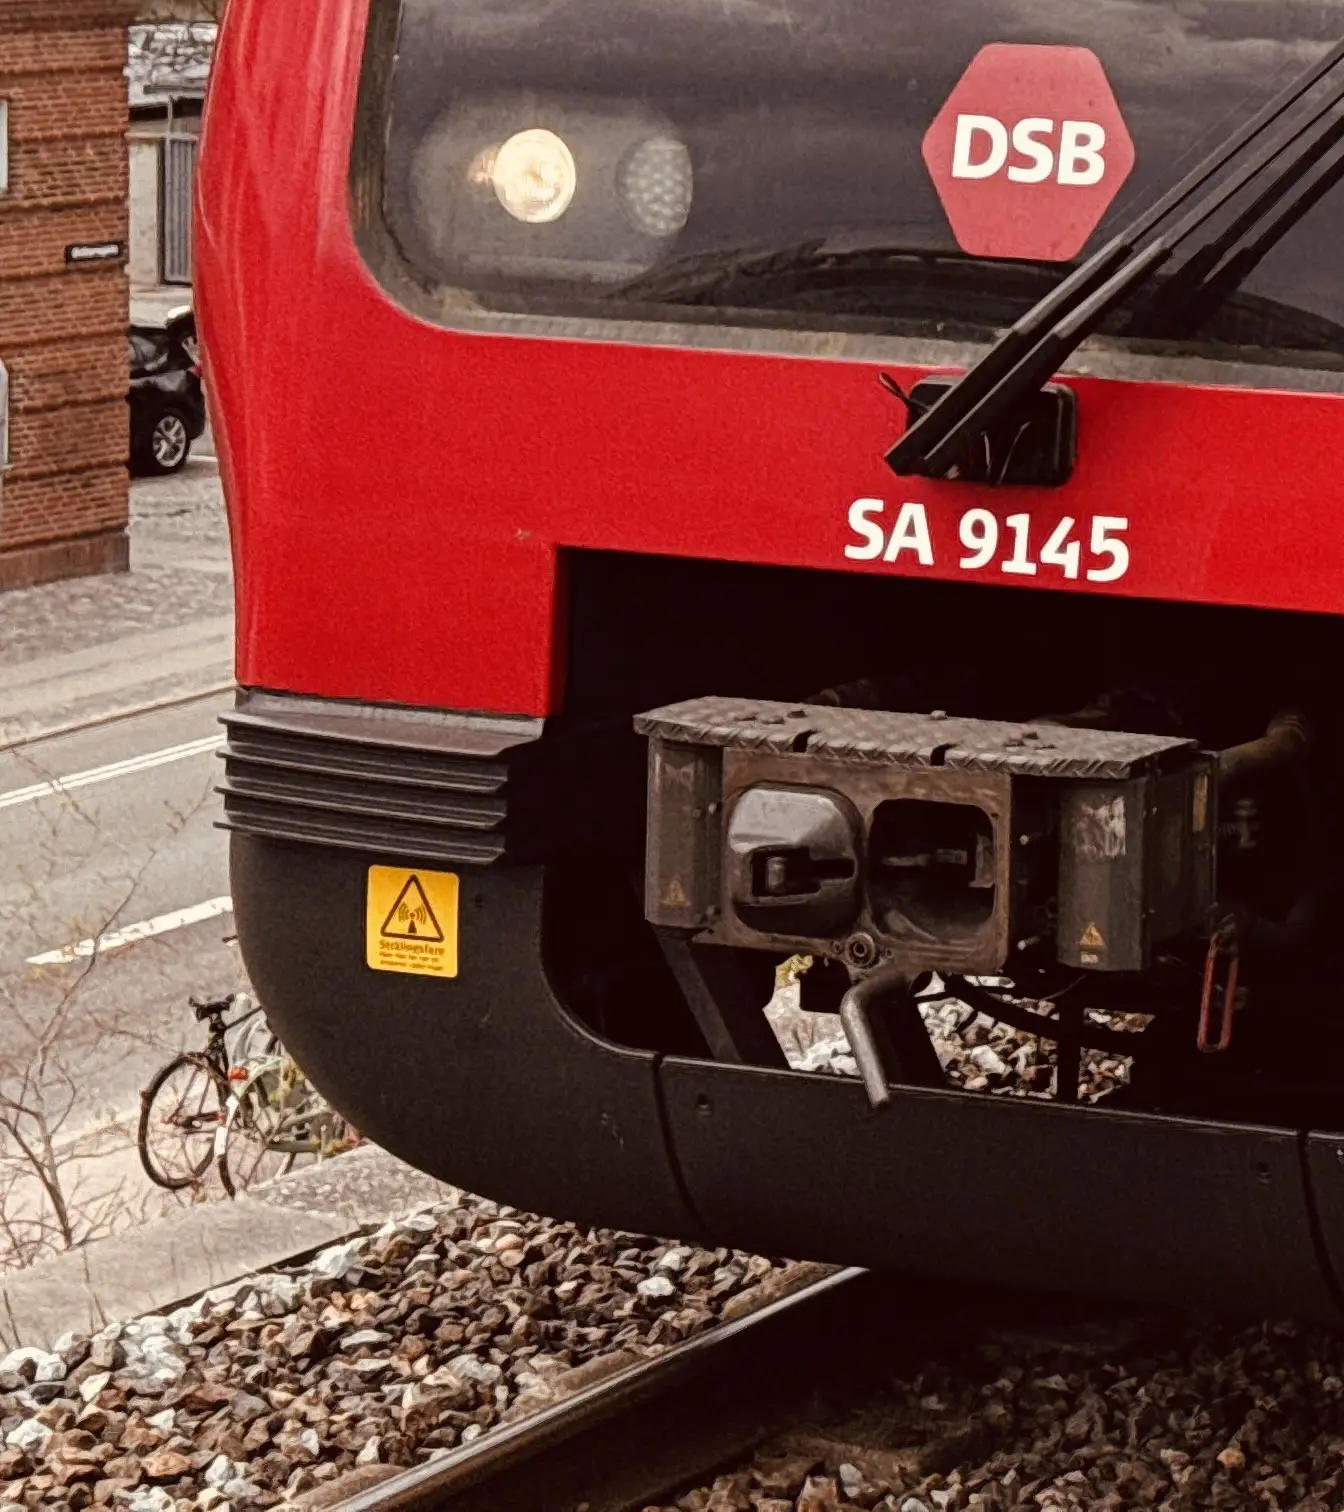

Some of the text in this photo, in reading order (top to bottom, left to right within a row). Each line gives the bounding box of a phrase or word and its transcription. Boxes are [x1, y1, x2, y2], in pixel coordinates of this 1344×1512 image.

[951, 114, 1106, 186] DSB
[844, 497, 1130, 582] SA 9145
